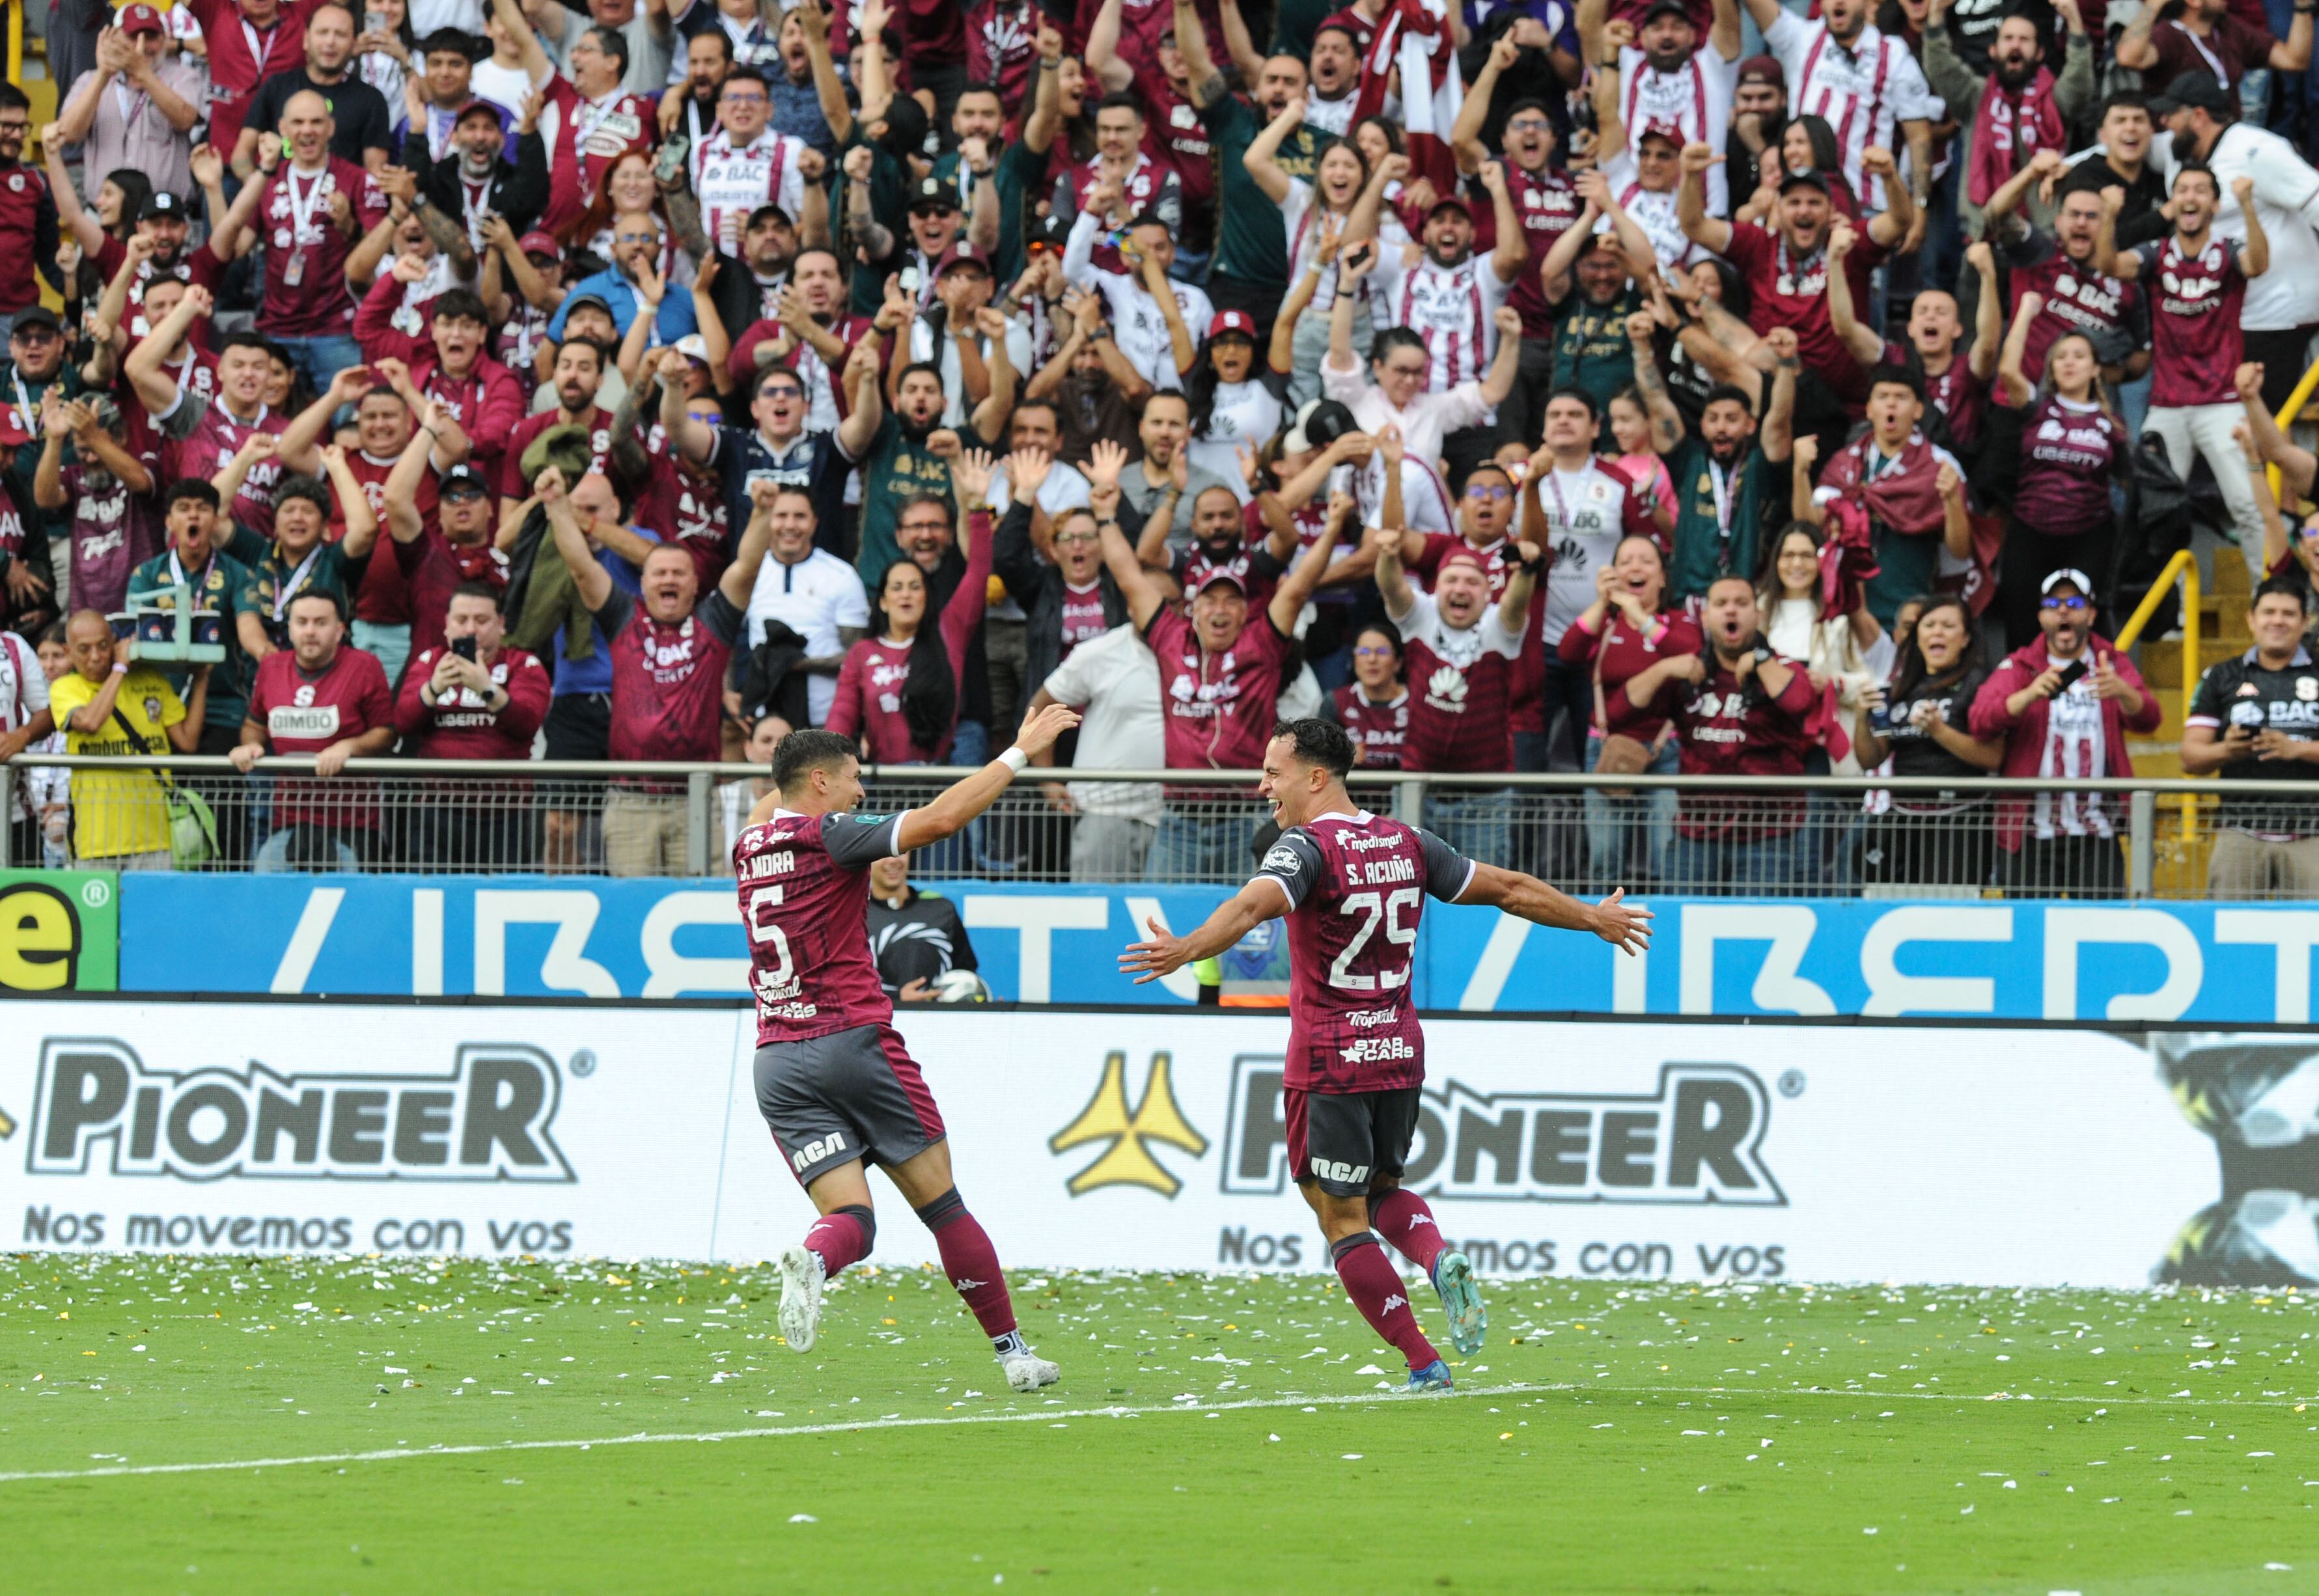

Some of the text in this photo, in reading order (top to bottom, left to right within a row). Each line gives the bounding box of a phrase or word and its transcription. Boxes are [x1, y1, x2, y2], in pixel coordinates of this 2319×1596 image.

[727, 166, 763, 182] BAC
[434, 713, 496, 726] LIBERTY
[1352, 831, 1403, 853] medismart
[738, 850, 795, 881] J. MORA
[1346, 856, 1415, 885] S. ACUÑA
[749, 885, 794, 985] 5
[1329, 887, 1421, 990] 25
[1354, 1037, 1403, 1051] STAR
[1364, 1045, 1414, 1061] CARS
[36, 1048, 557, 1170] PIONEER
[793, 1131, 846, 1173] RCA
[1311, 1157, 1369, 1183] RCA
[23, 1205, 573, 1252] Nos movemos con vos
[1219, 1226, 1303, 1267] Nos
[1579, 1242, 1672, 1274] con
[1698, 1244, 1784, 1277] vos
